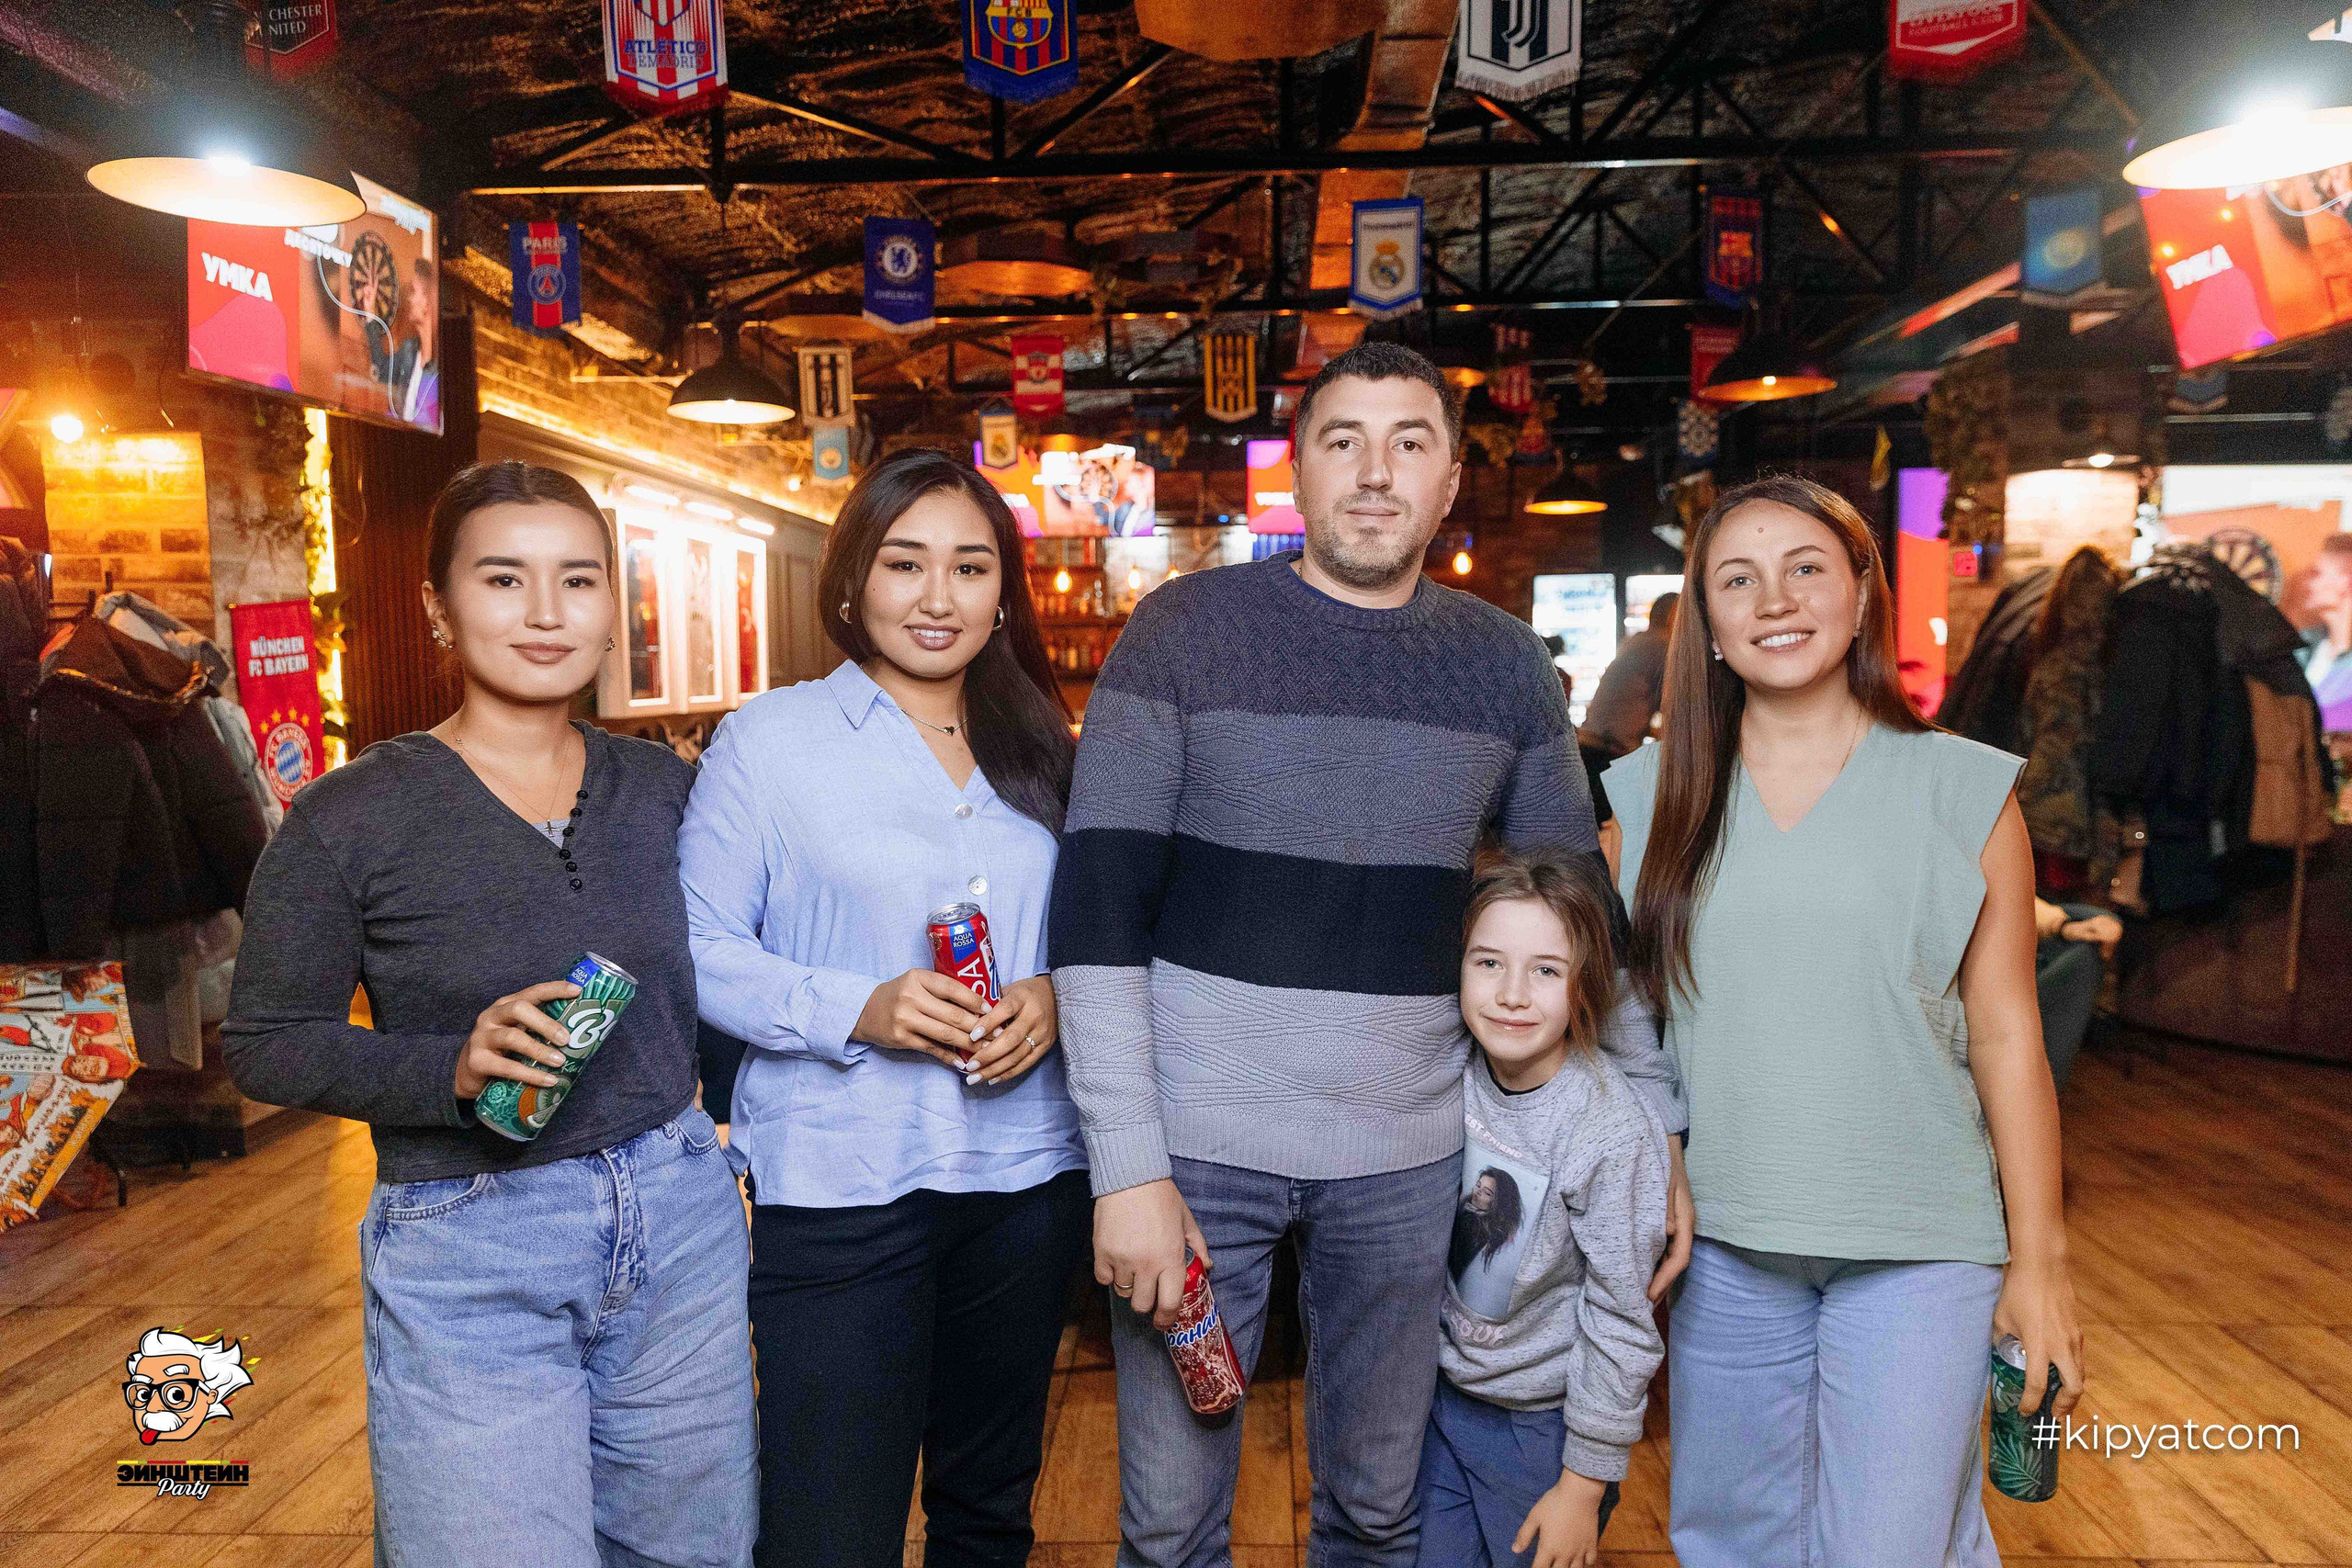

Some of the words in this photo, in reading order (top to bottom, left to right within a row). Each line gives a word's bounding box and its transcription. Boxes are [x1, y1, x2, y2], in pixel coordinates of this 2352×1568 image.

[267, 3, 323, 20] CHESTER
[267, 20, 307, 36] NITED
[624, 37, 707, 54] ATLÉTICO
[200, 252, 273, 302] УМКА
[250, 636, 305, 658] MÜNCHEN
[249, 659, 263, 677] FC
[264, 653, 309, 677] BAYERN
[953, 938, 975, 948] ROSSA
[954, 931, 973, 942] AQUA
[571, 972, 586, 985] ROSSA
[574, 967, 589, 979] AQUA
[1464, 1112, 1485, 1133] EST
